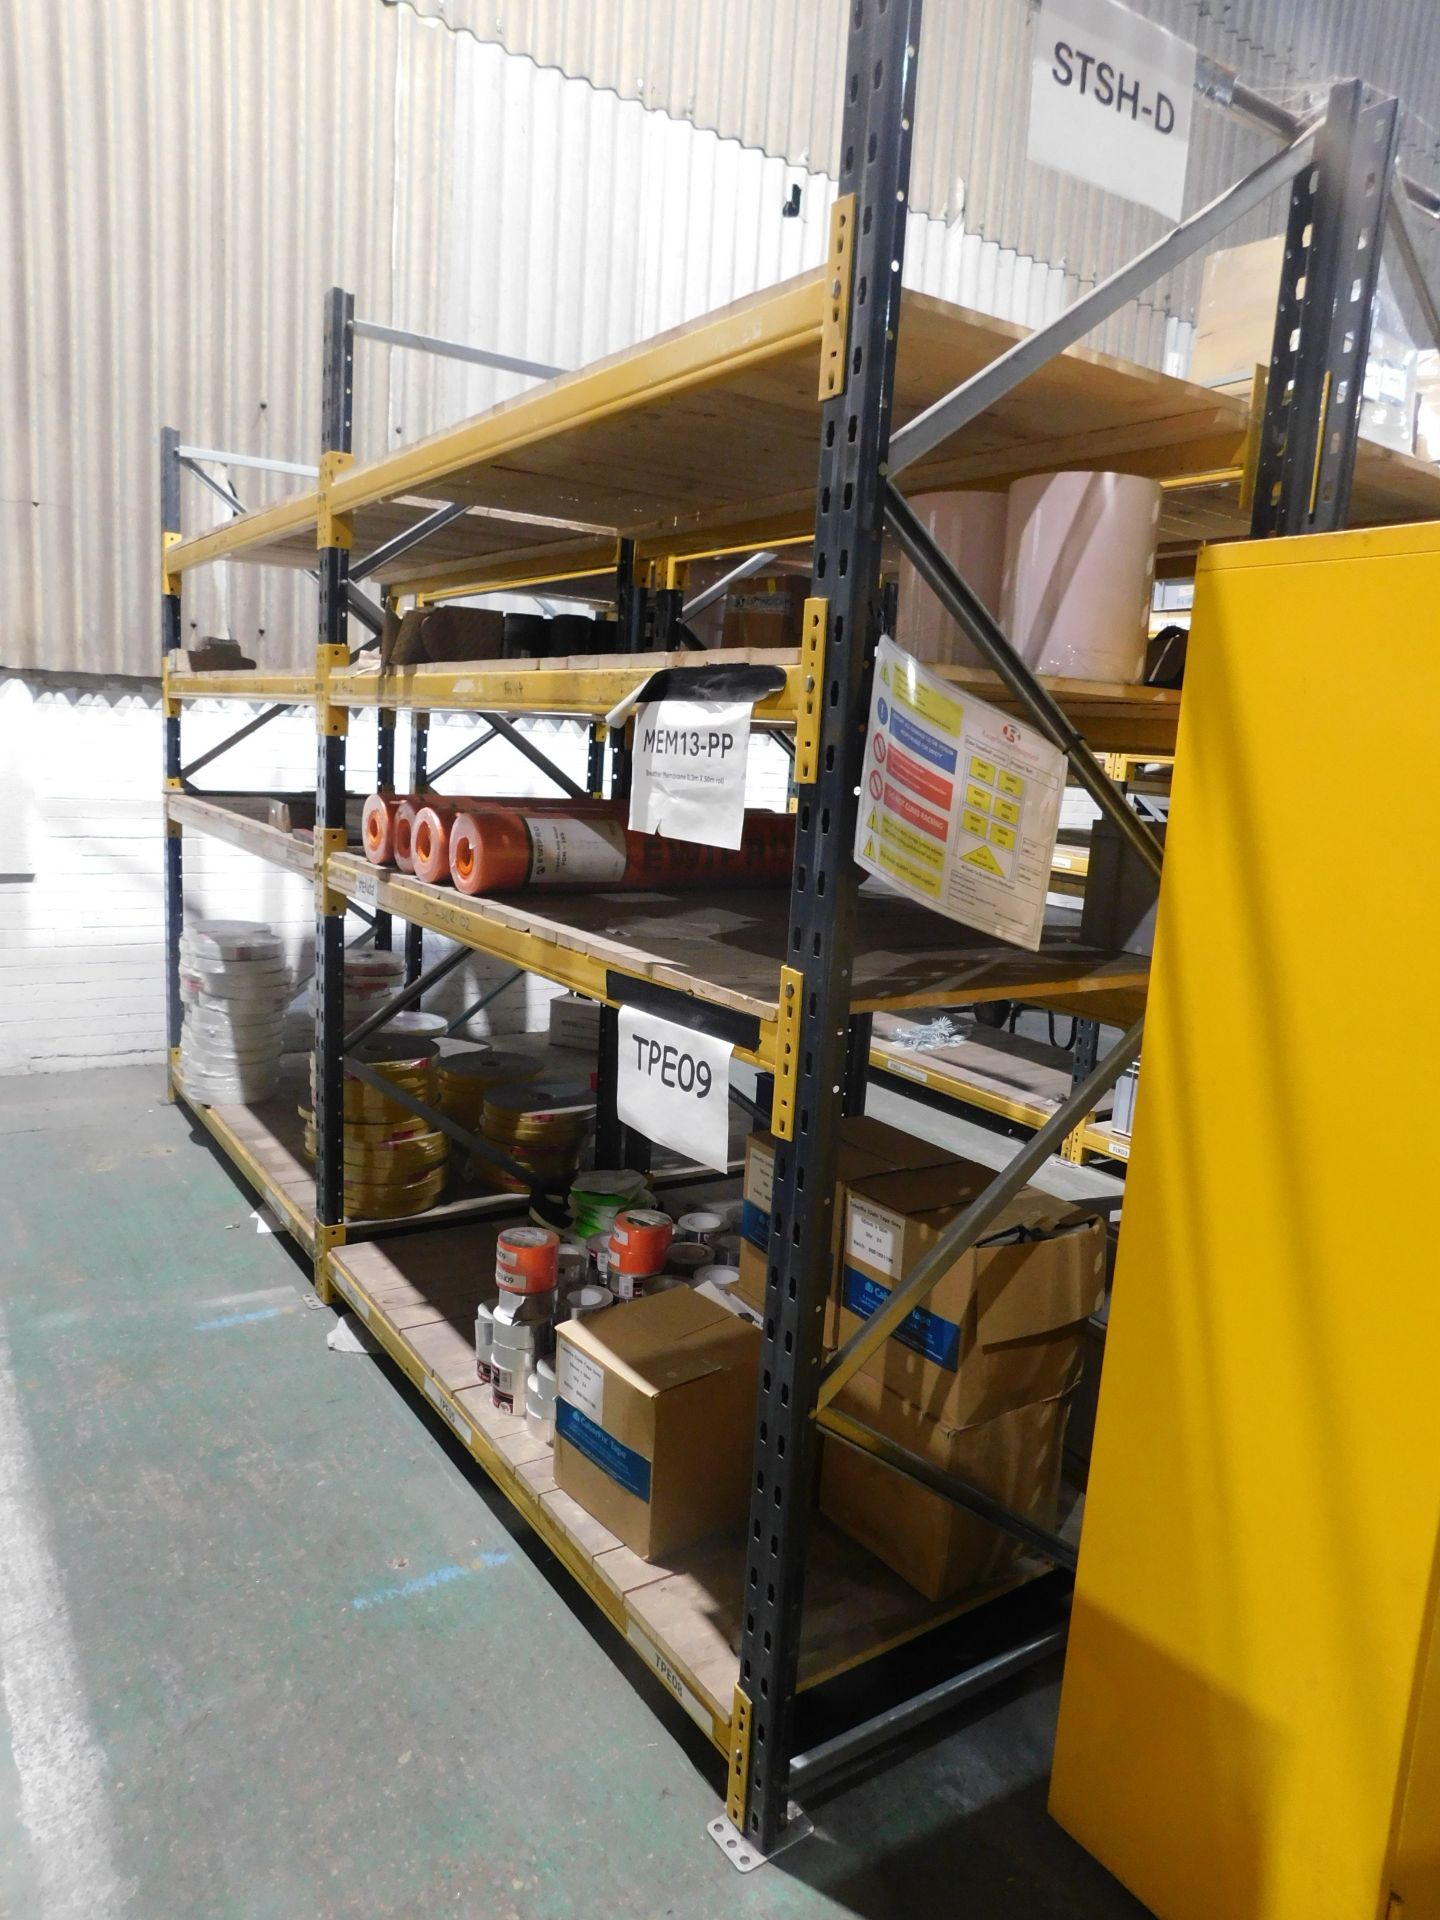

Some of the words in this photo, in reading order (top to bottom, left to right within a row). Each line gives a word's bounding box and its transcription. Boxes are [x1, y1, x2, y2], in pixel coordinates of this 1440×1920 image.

[1052, 41, 1175, 135] STSH-D
[643, 729, 734, 759] MEM13-PP
[533, 826, 544, 863] EWIPRO
[632, 1034, 712, 1098] TPE09
